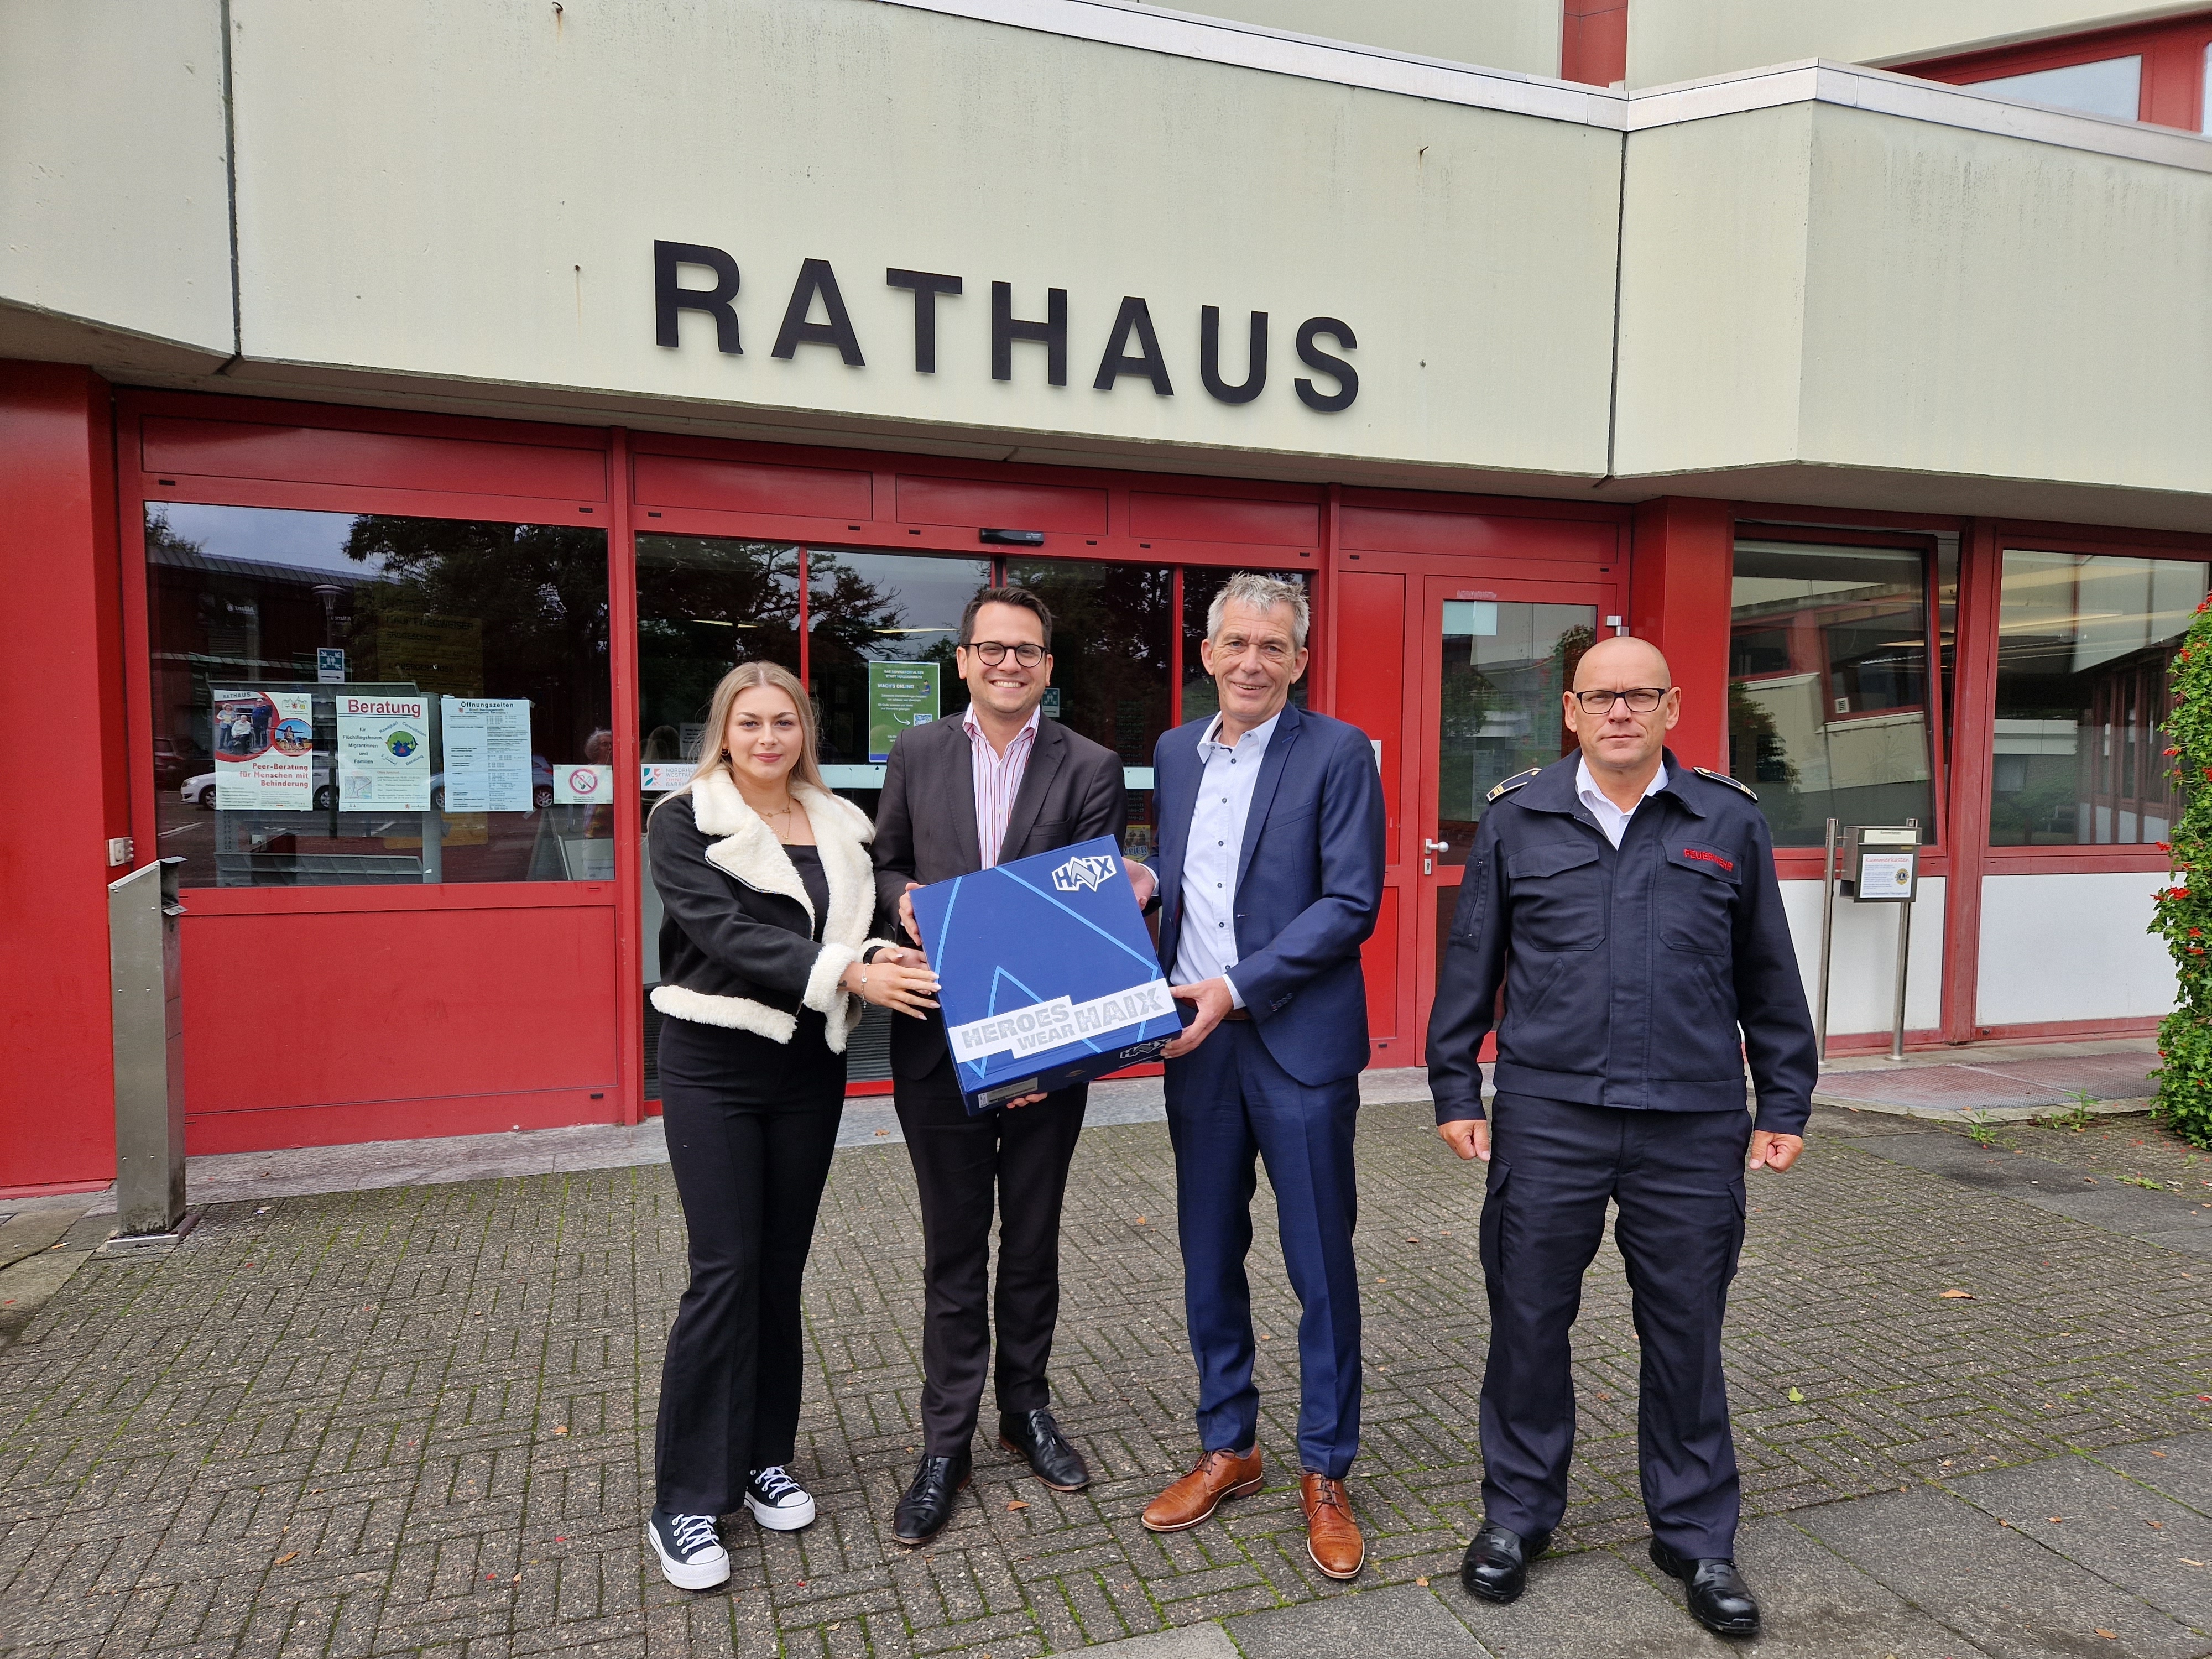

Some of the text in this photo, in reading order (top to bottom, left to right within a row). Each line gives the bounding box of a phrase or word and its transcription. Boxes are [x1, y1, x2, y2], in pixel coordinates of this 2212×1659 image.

[653, 239, 1360, 413] RATHAUS
[348, 699, 421, 718] Beratung
[402, 721, 427, 737] Consultation
[252, 763, 309, 772] Peer-Beratung
[405, 754, 424, 766] Beratung
[260, 780, 309, 789] Behinderung
[1683, 848, 1734, 872] FEUERWEHR
[1051, 855, 1117, 893] HAIX
[961, 987, 1164, 1051] HEROES WEAR HAIX
